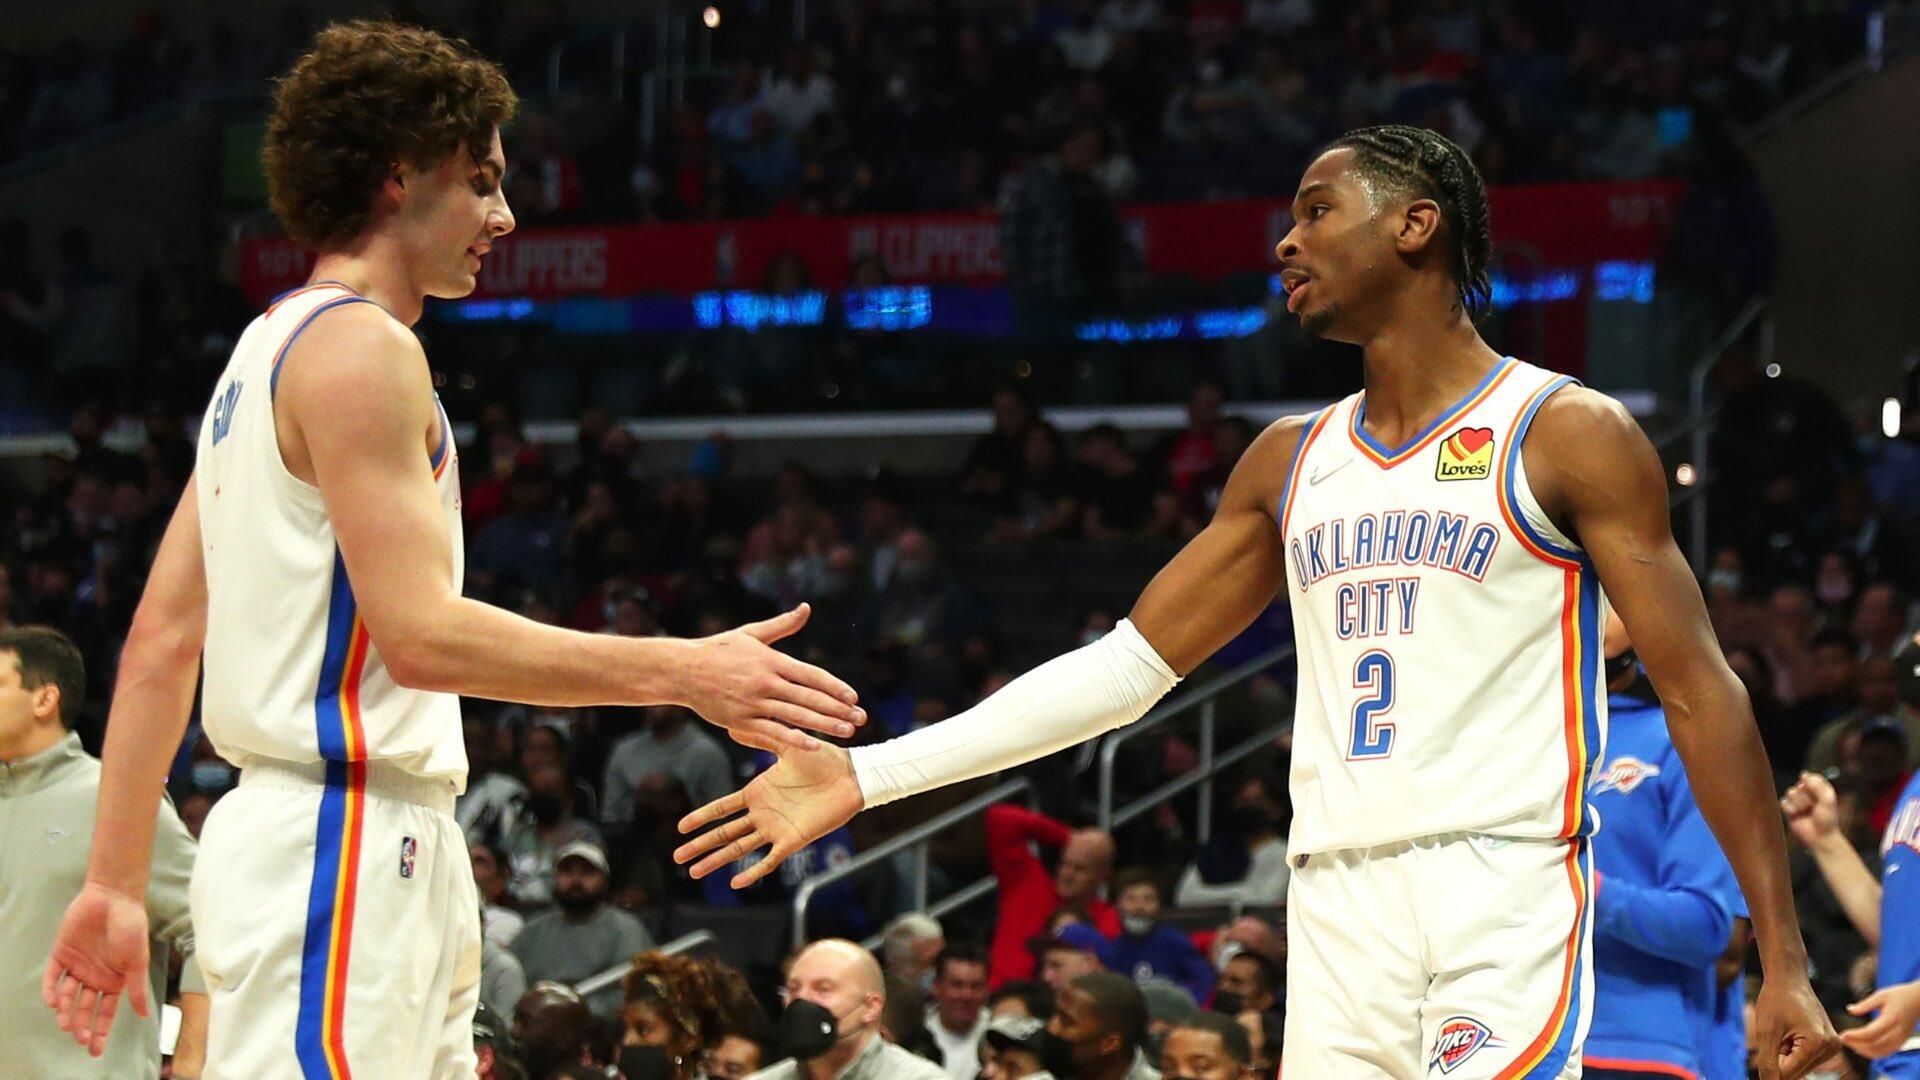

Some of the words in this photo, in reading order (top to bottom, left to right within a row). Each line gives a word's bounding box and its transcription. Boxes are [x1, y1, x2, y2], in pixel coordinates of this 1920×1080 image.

[1440, 460, 1487, 476] Love's
[1291, 510, 1500, 593] OKLAHOMA
[1336, 577, 1420, 640] CITY
[1346, 649, 1396, 761] 2
[1430, 1029, 1476, 1064] OKC
